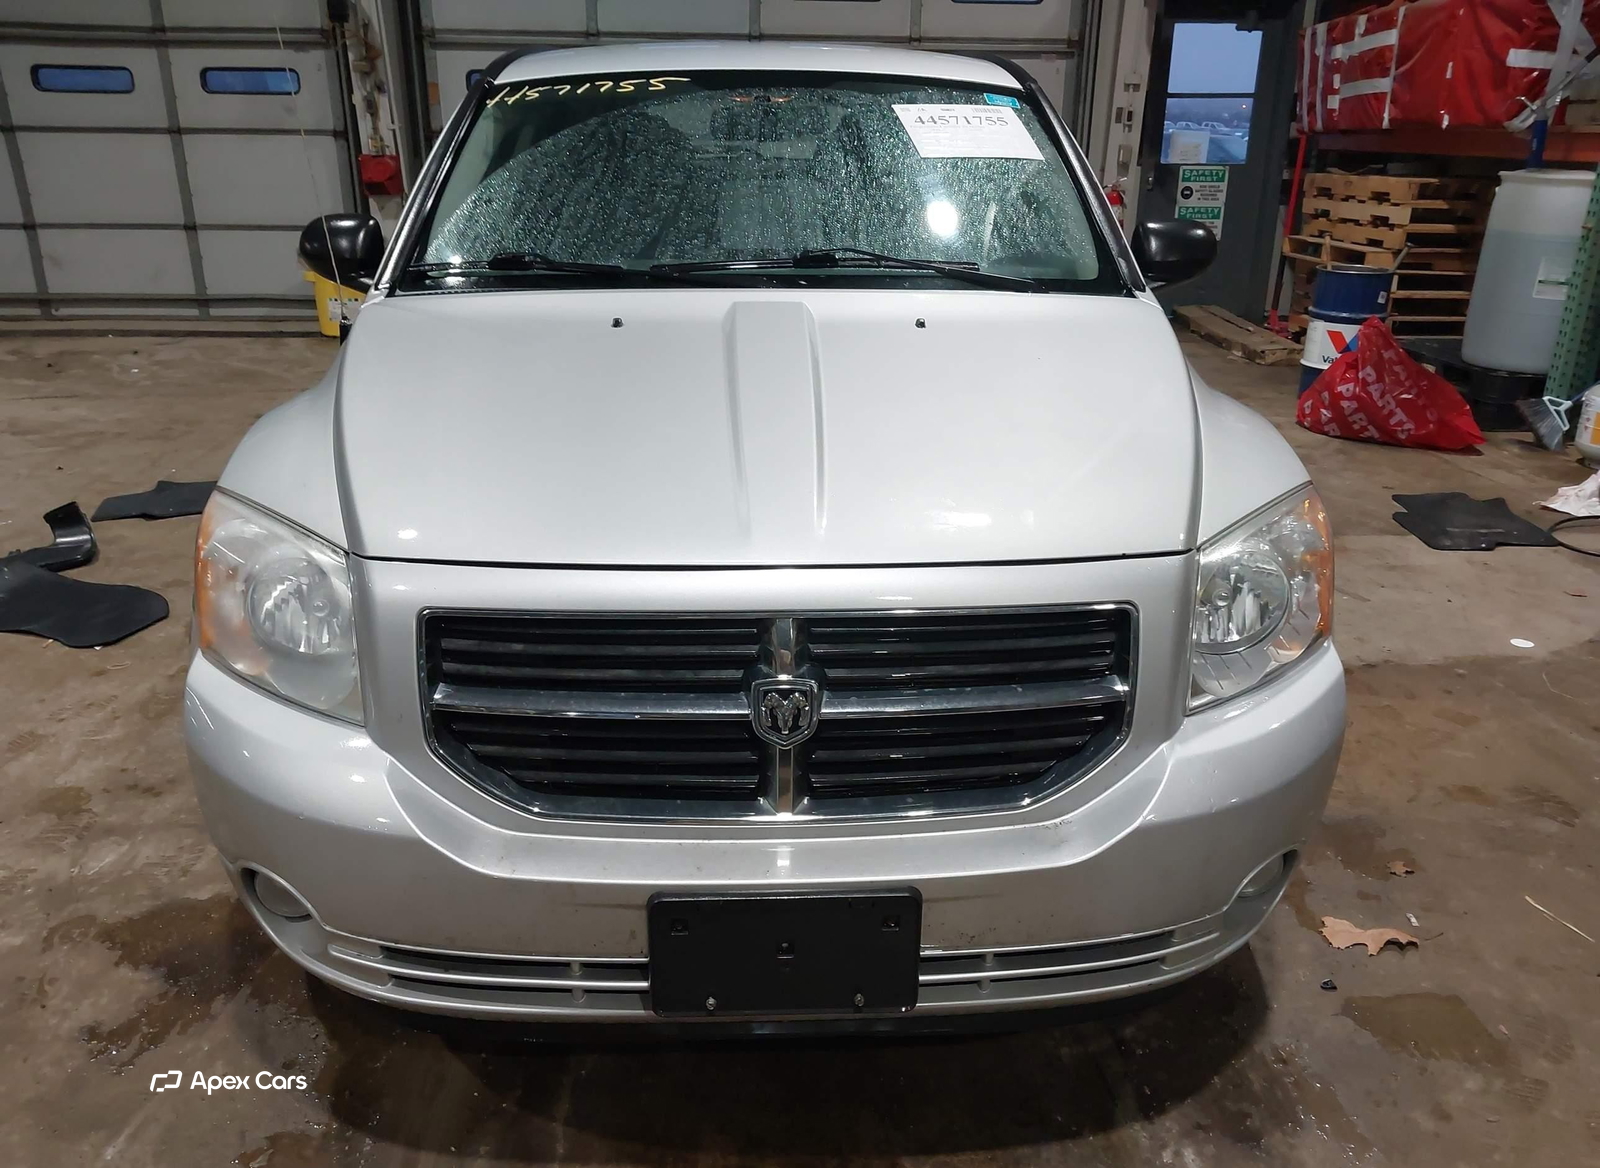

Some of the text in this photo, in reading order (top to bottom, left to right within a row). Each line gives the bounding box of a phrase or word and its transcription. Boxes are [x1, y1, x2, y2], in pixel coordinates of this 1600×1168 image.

[914, 115, 1009, 127] 44571755
[1184, 169, 1224, 178] SAFETY
[1358, 365, 1415, 439] PARTS
